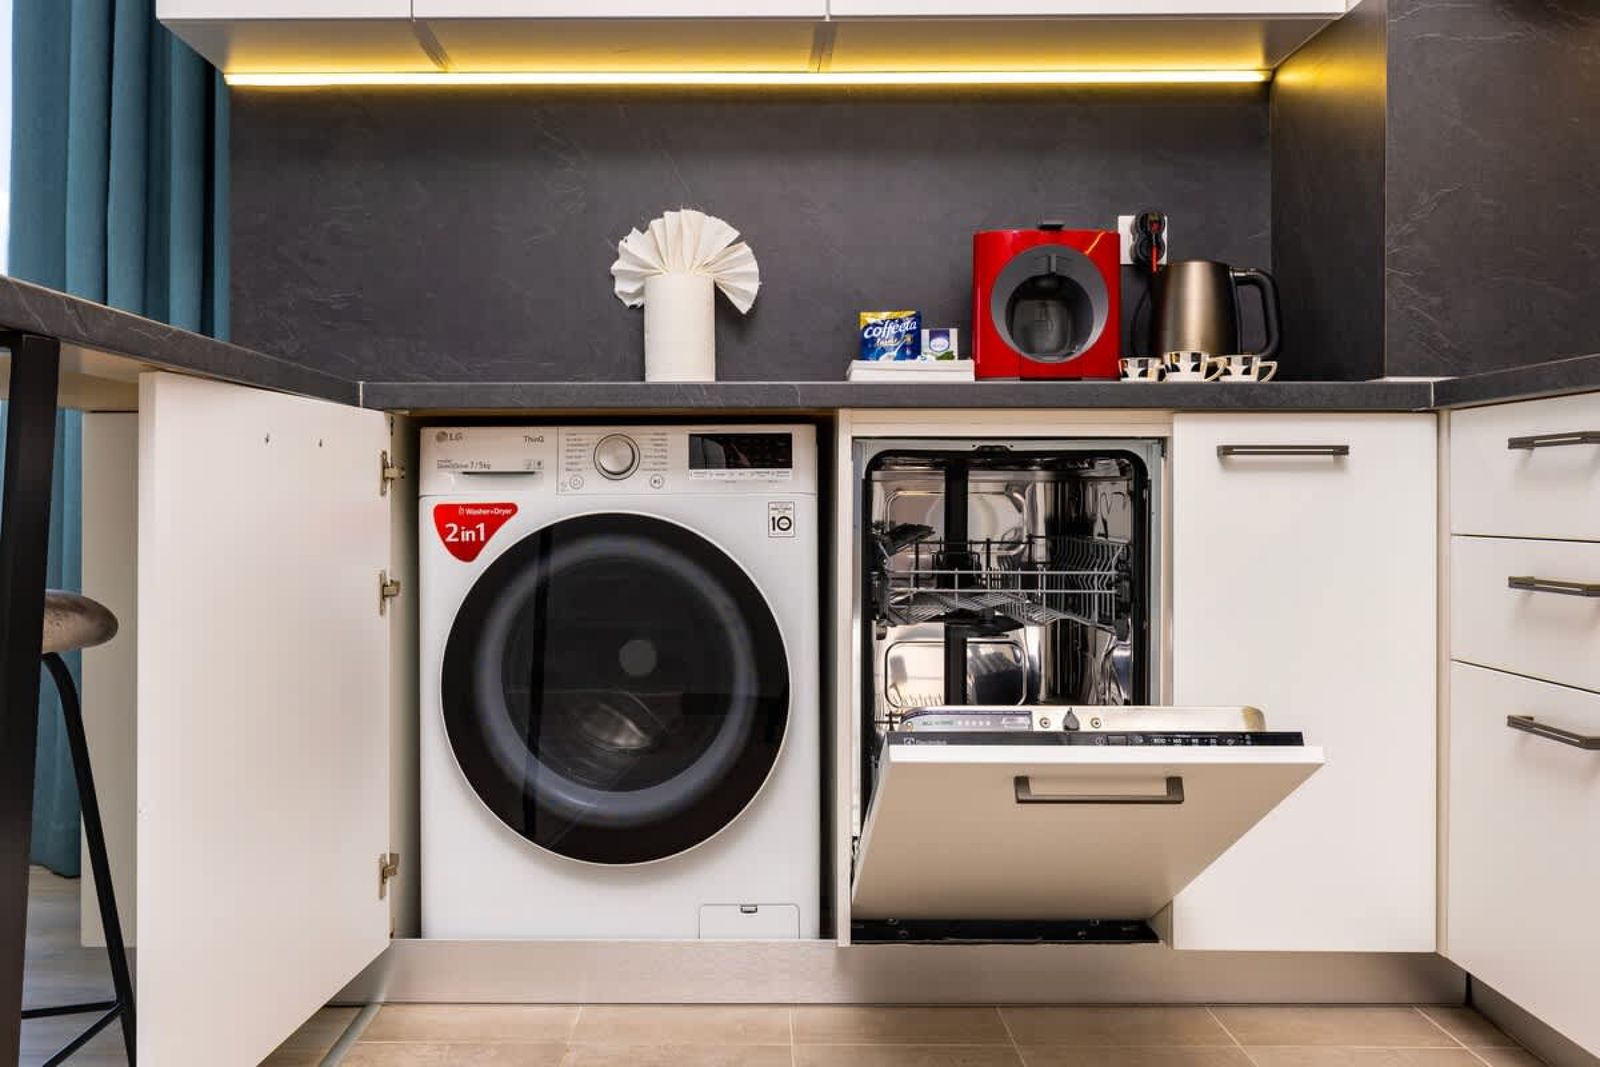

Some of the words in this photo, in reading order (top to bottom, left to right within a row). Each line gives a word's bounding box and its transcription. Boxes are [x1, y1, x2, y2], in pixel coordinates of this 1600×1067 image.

[448, 433, 463, 441] LG
[523, 435, 545, 443] ThinQ
[772, 516, 792, 531] 10
